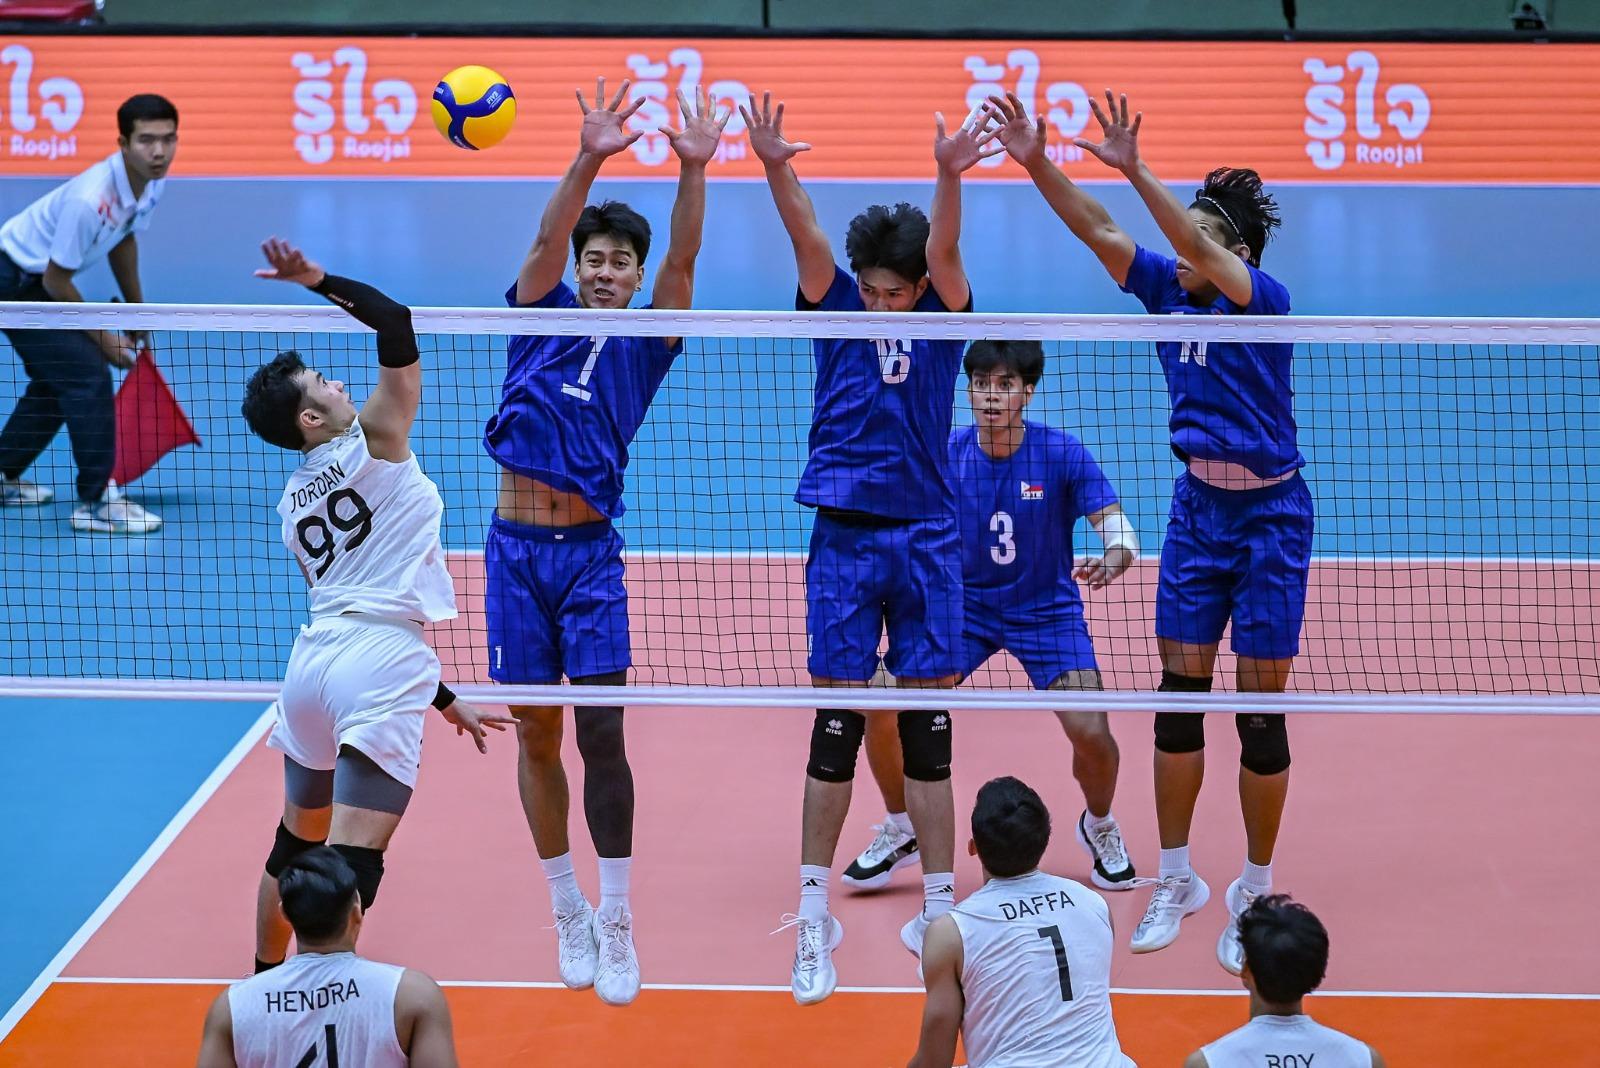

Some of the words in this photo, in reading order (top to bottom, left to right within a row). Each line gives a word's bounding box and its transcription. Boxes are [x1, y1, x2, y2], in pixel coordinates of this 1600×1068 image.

[291, 46, 418, 164] รู้ใจ
[1303, 50, 1430, 170] รู้ใจ
[10, 134, 77, 160] Roojai
[343, 135, 411, 163] Roojai
[1045, 142, 1084, 166] ojai
[1356, 142, 1423, 168] Roojai
[291, 461, 345, 513] JORDAN
[297, 488, 373, 580] 99
[990, 511, 1016, 565] 3
[495, 646, 502, 669] 1
[999, 891, 1075, 920] DAFFA
[1037, 925, 1073, 1001] 1
[265, 978, 360, 1013] HENDRA
[1265, 1053, 1315, 1068] BOY
